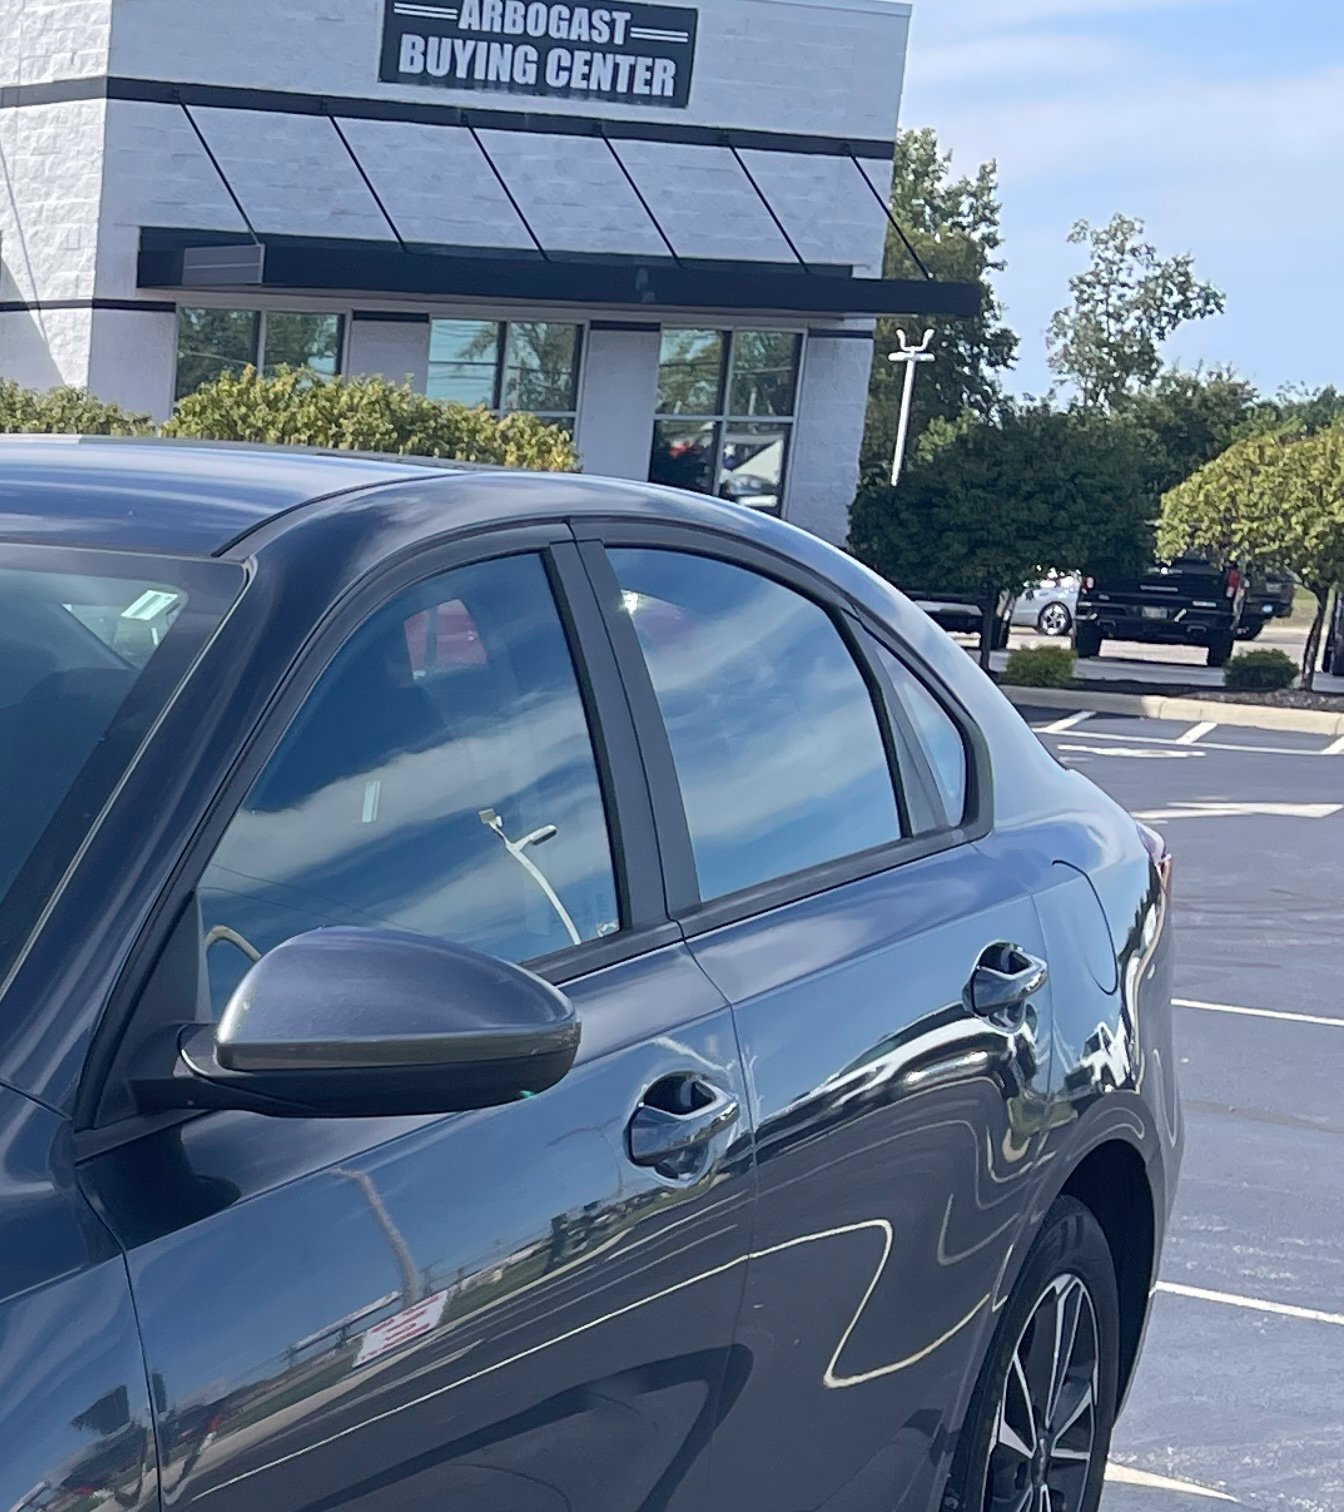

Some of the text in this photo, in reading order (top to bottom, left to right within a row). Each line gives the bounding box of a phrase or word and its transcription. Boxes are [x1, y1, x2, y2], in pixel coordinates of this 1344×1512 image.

[458, 0, 632, 45] ARBOGAST
[398, 34, 677, 97] BUYING CENTER
